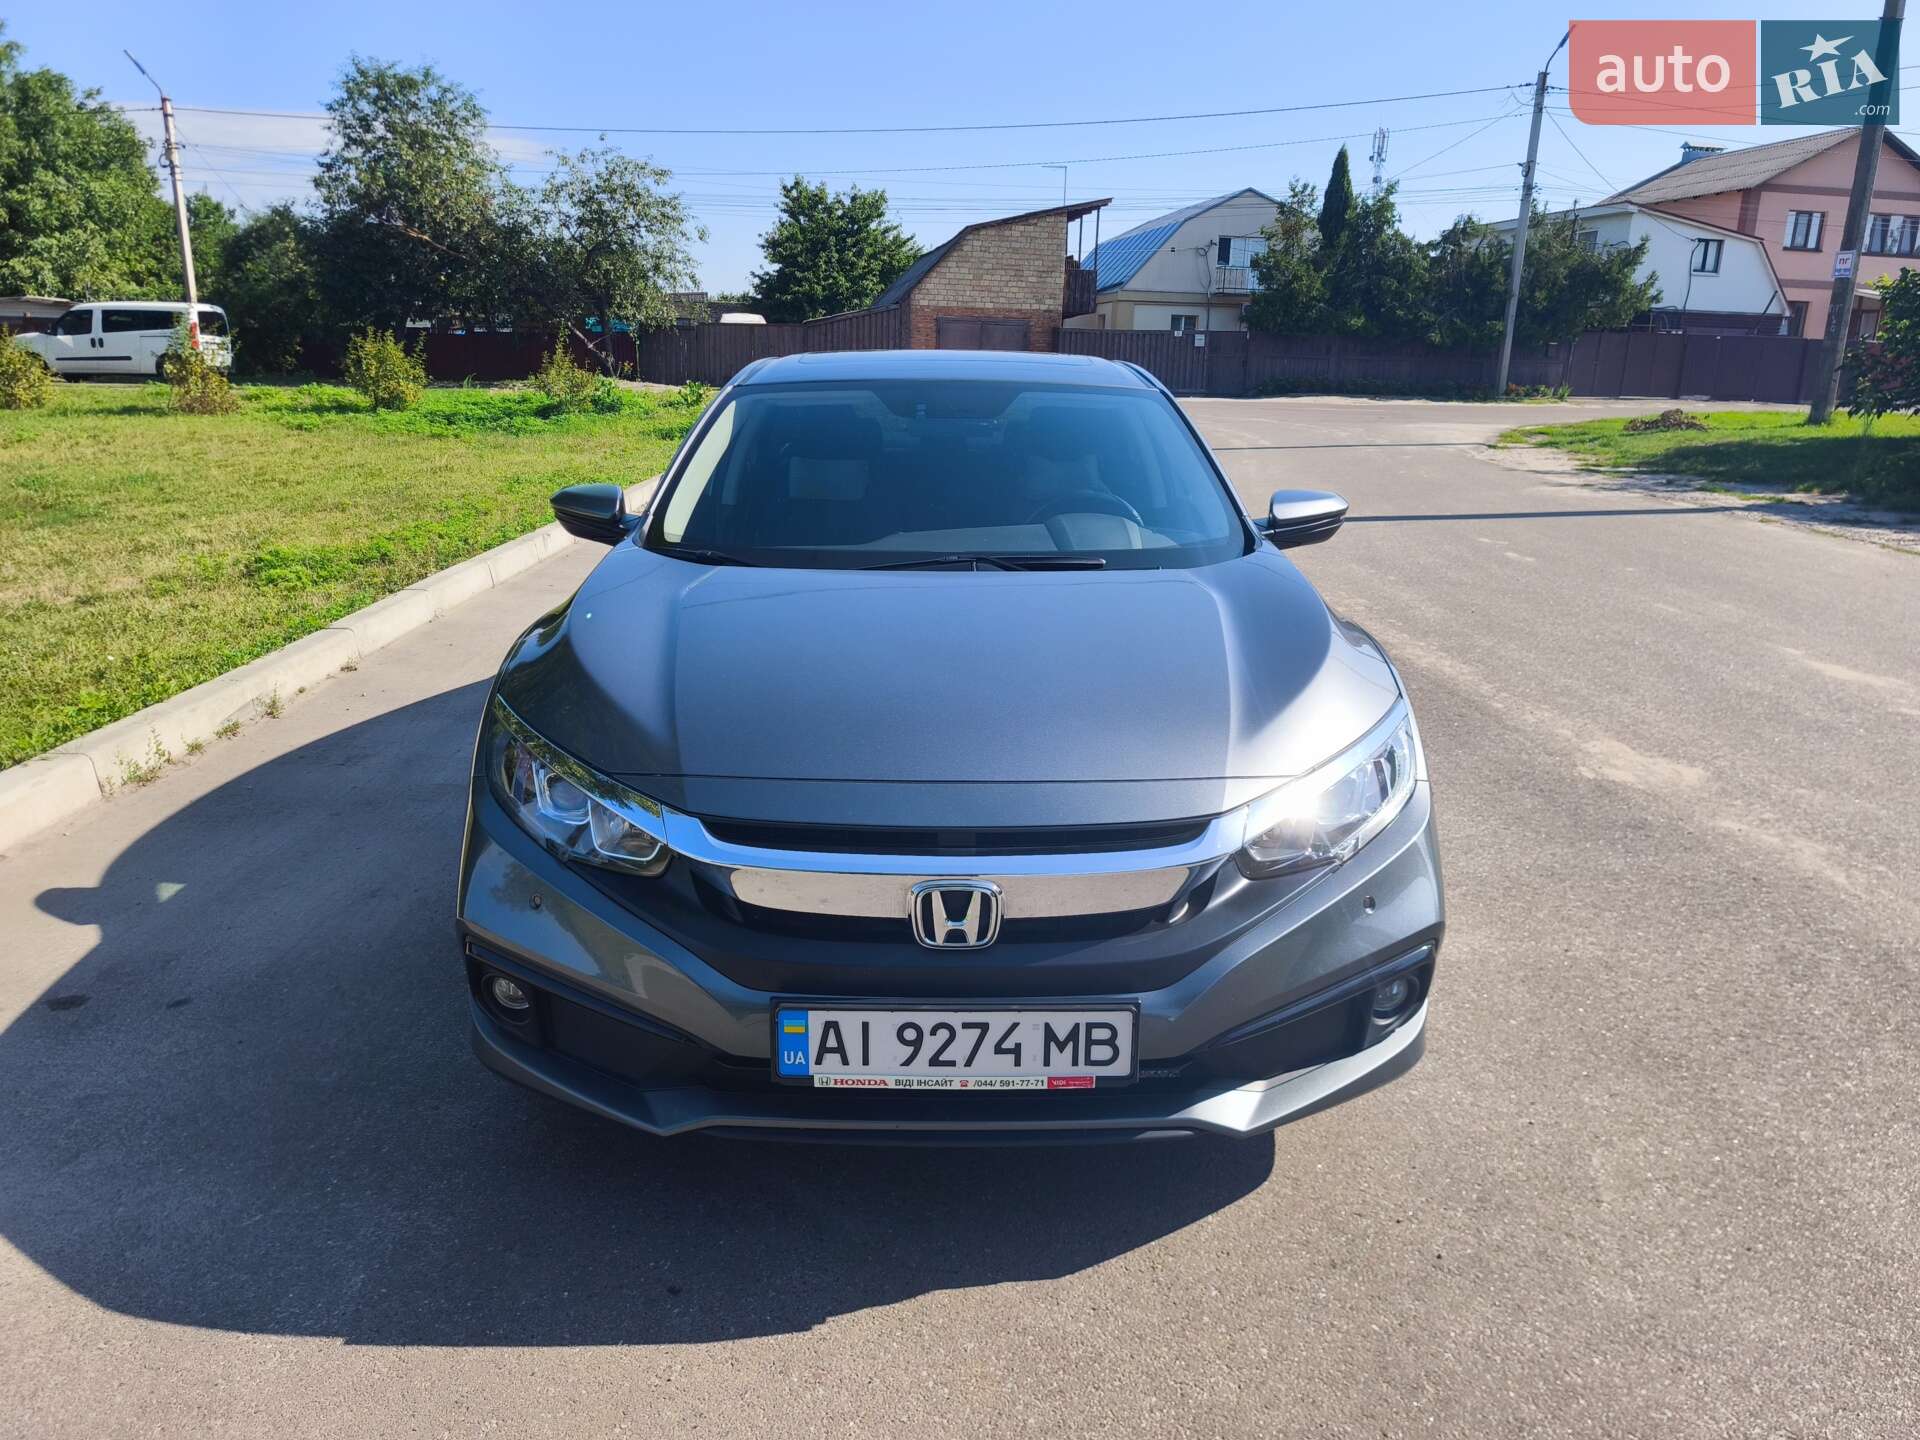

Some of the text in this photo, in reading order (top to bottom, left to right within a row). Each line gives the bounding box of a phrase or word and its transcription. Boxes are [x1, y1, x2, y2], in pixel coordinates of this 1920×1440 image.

[814, 1020, 1121, 1068] AI 9274 MB
[783, 1050, 806, 1065] UA
[833, 1078, 889, 1087] HONDA
[916, 1079, 954, 1088] ІНСАЙТ
[973, 1079, 998, 1088] /044/
[999, 1079, 1045, 1088] 591-77-71
